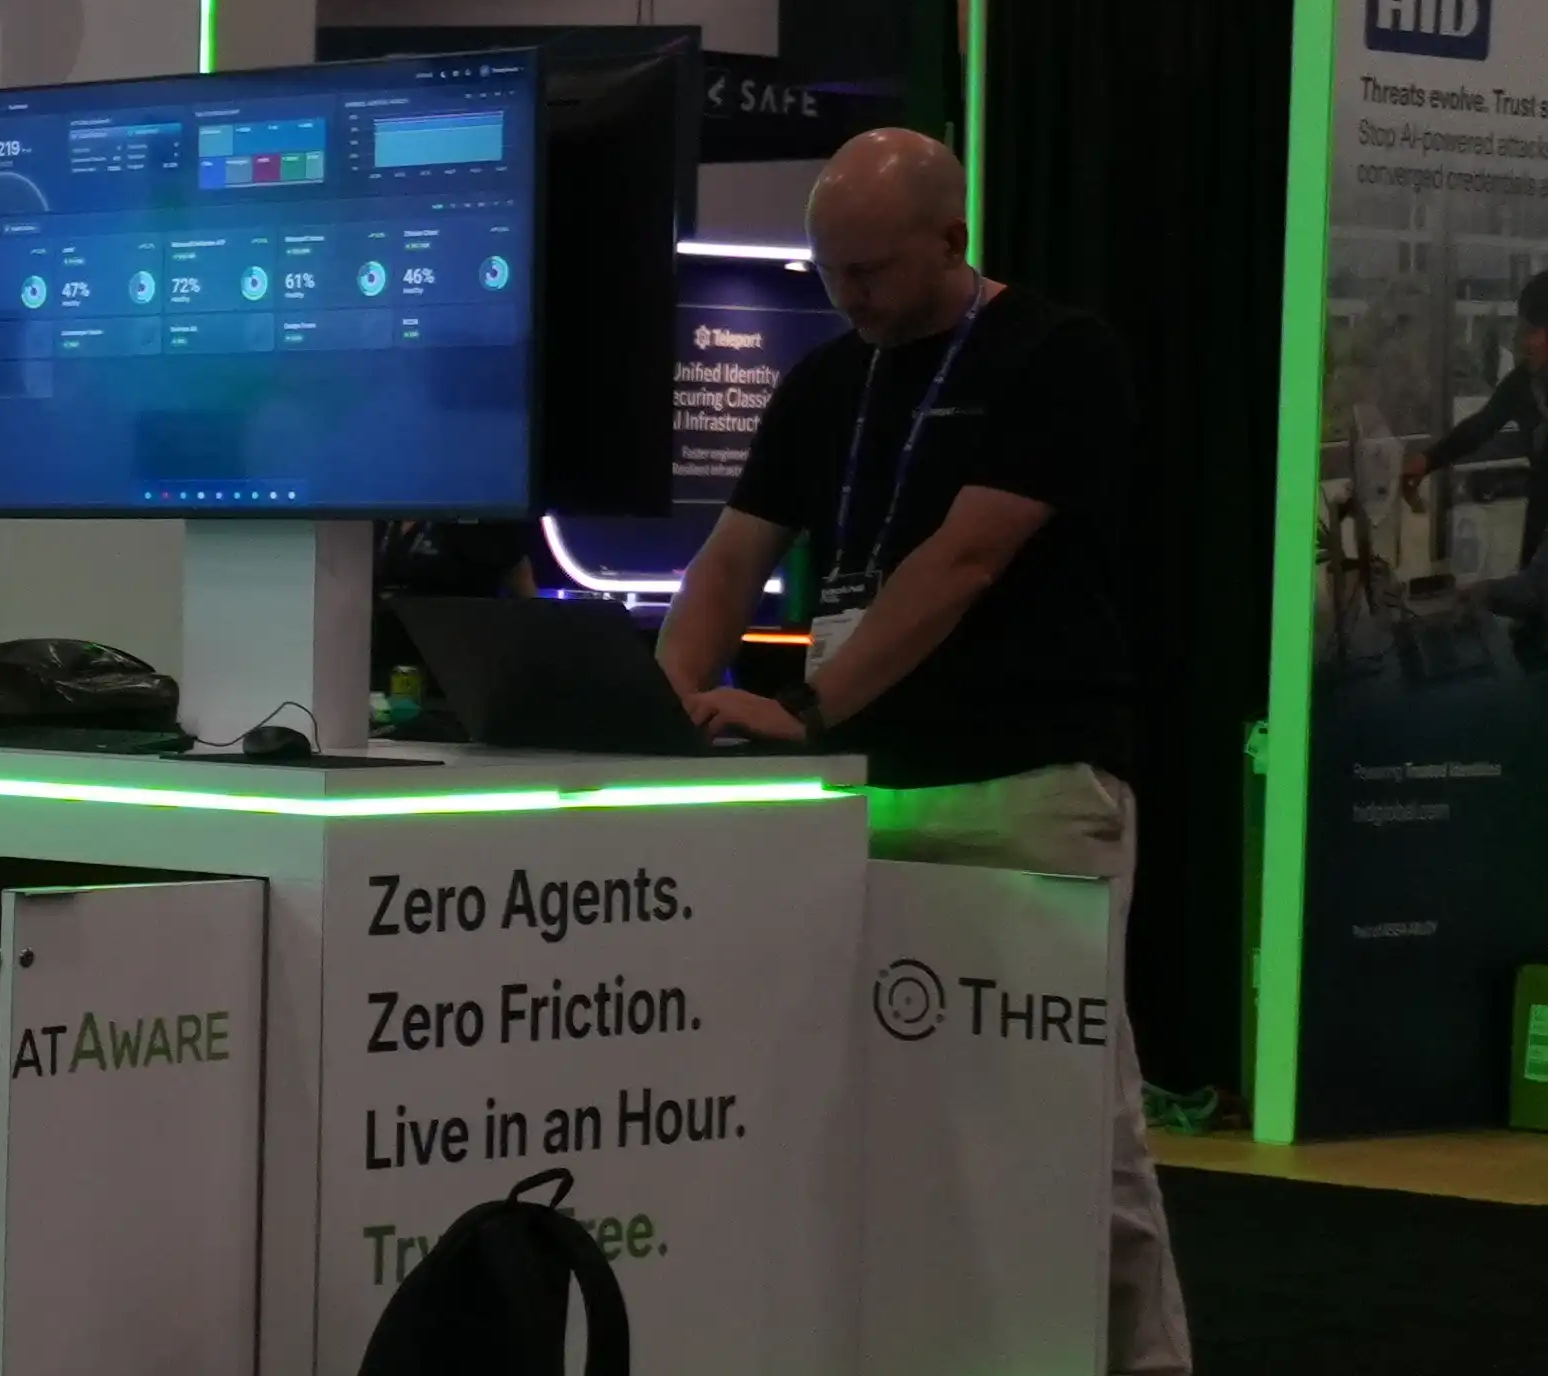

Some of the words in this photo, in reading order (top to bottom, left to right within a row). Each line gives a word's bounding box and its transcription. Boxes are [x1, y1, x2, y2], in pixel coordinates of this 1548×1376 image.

[740, 78, 819, 117] SAFE
[1360, 76, 1425, 109] Threats
[713, 328, 762, 350] Teleport
[725, 362, 779, 389] Identity
[367, 874, 486, 936] Zero
[500, 867, 693, 943] Agents.
[366, 991, 484, 1052] Zero
[500, 974, 702, 1044] Friction.
[958, 977, 1107, 1047] THRE
[365, 1104, 469, 1170] Live
[484, 1097, 527, 1159] in
[542, 1104, 602, 1154] an
[617, 1087, 746, 1148] Hour.
